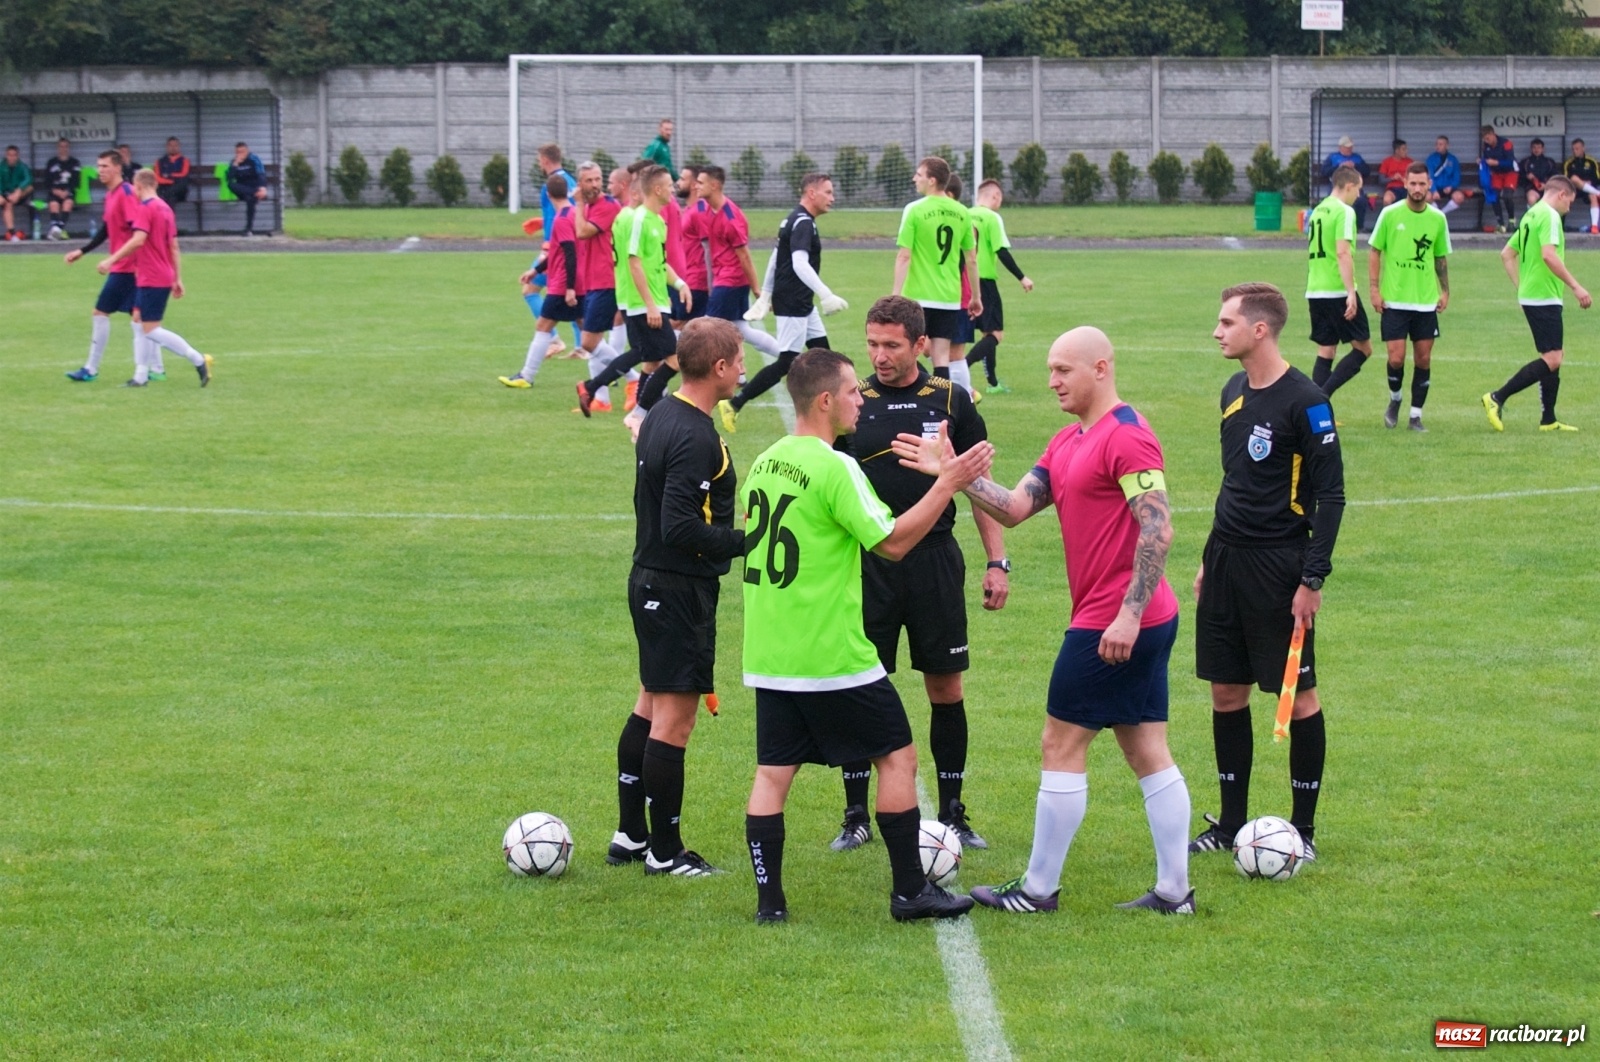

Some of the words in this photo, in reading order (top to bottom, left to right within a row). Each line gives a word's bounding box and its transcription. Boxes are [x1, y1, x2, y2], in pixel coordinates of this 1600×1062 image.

[1493, 111, 1553, 128] GOŚCIE
[936, 223, 953, 265] 9
[1136, 471, 1154, 490] C
[744, 488, 800, 589] 26
